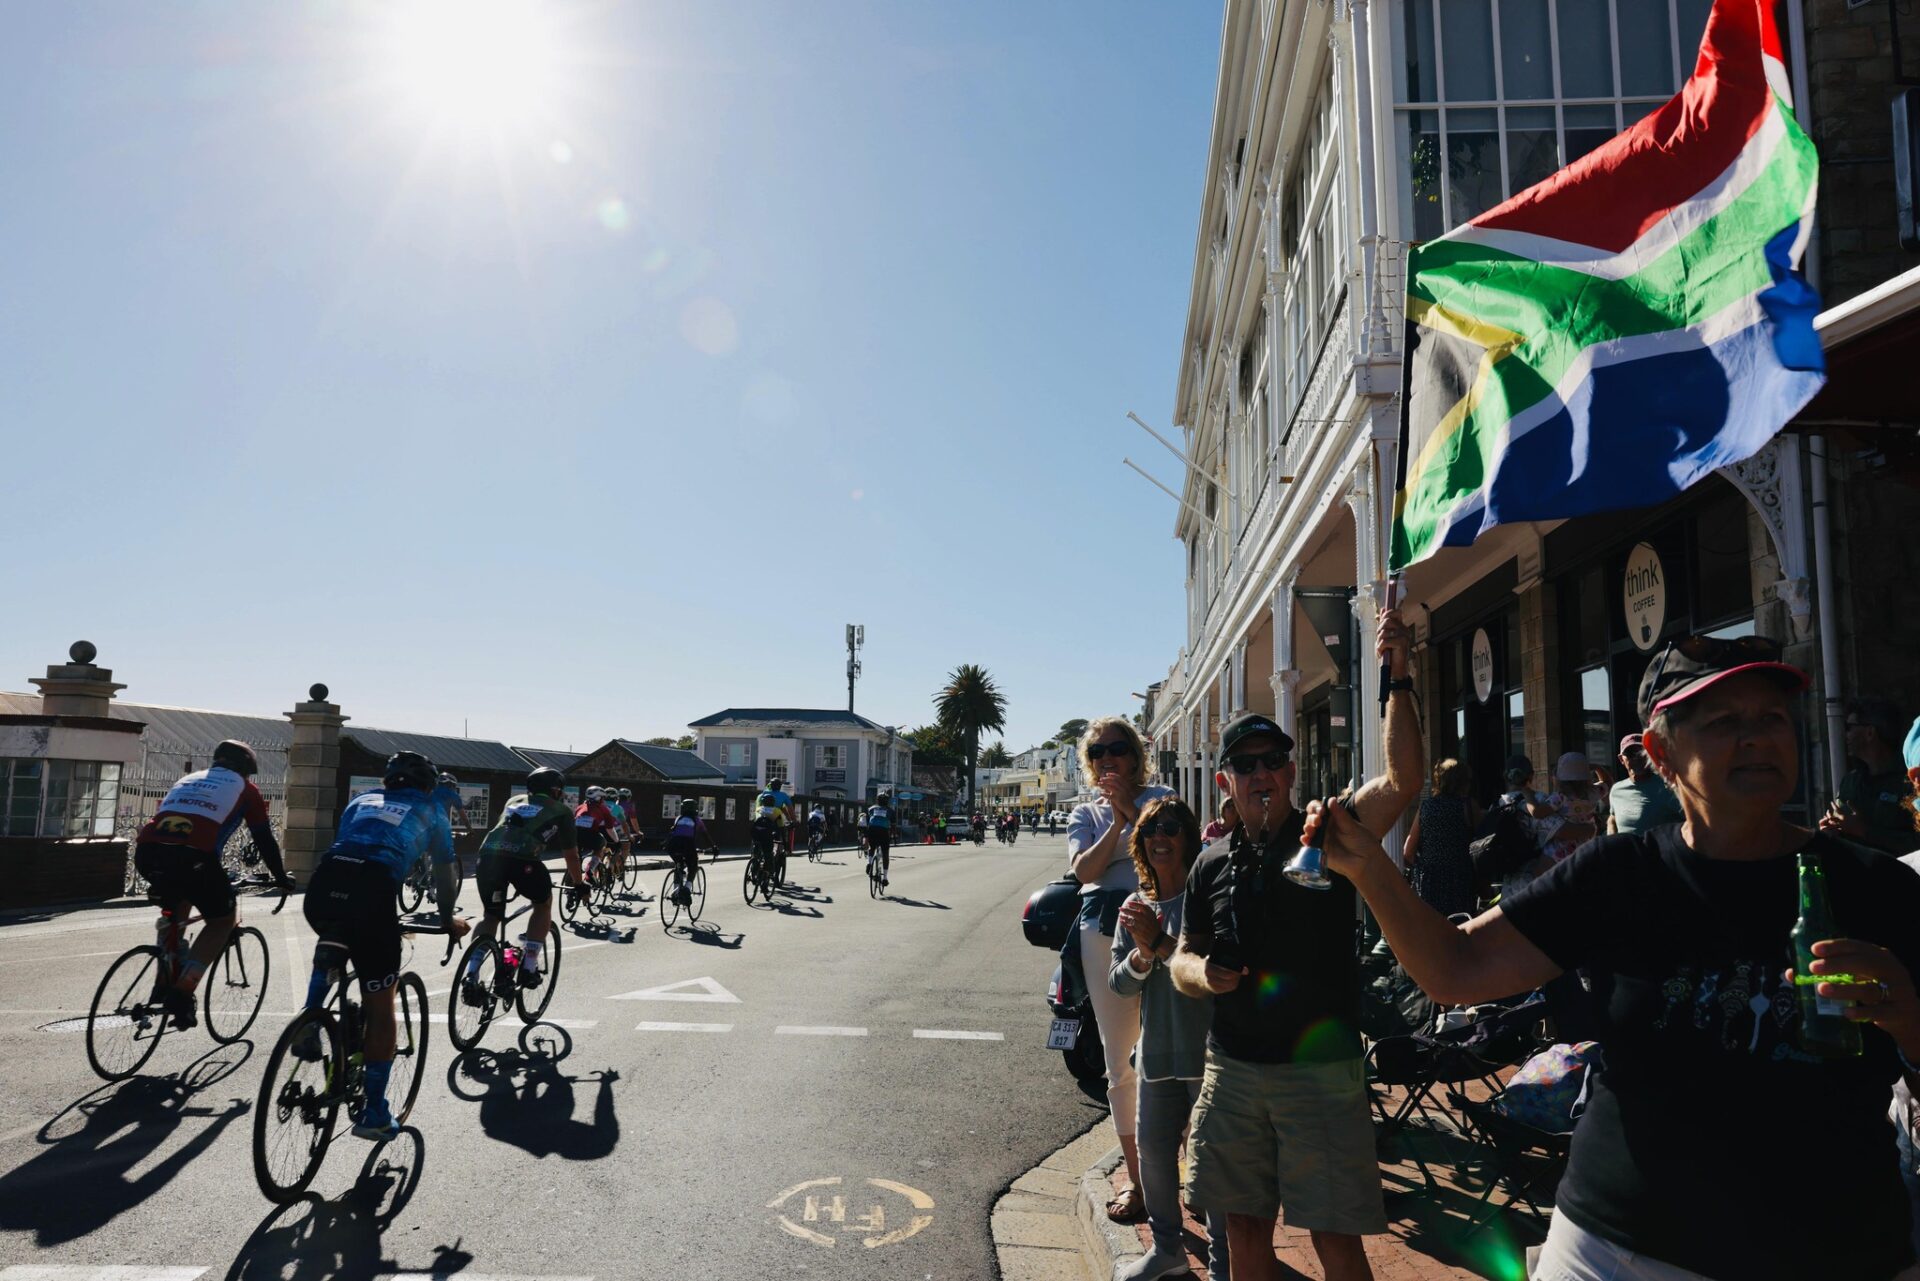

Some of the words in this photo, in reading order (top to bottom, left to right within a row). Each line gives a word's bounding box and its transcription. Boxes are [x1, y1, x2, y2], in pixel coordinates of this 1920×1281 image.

[1626, 559, 1659, 598] think
[1633, 595, 1655, 613] COFFEE
[1473, 647, 1491, 672] think
[177, 798, 218, 811] MOTORS
[1053, 1022, 1062, 1032] CA
